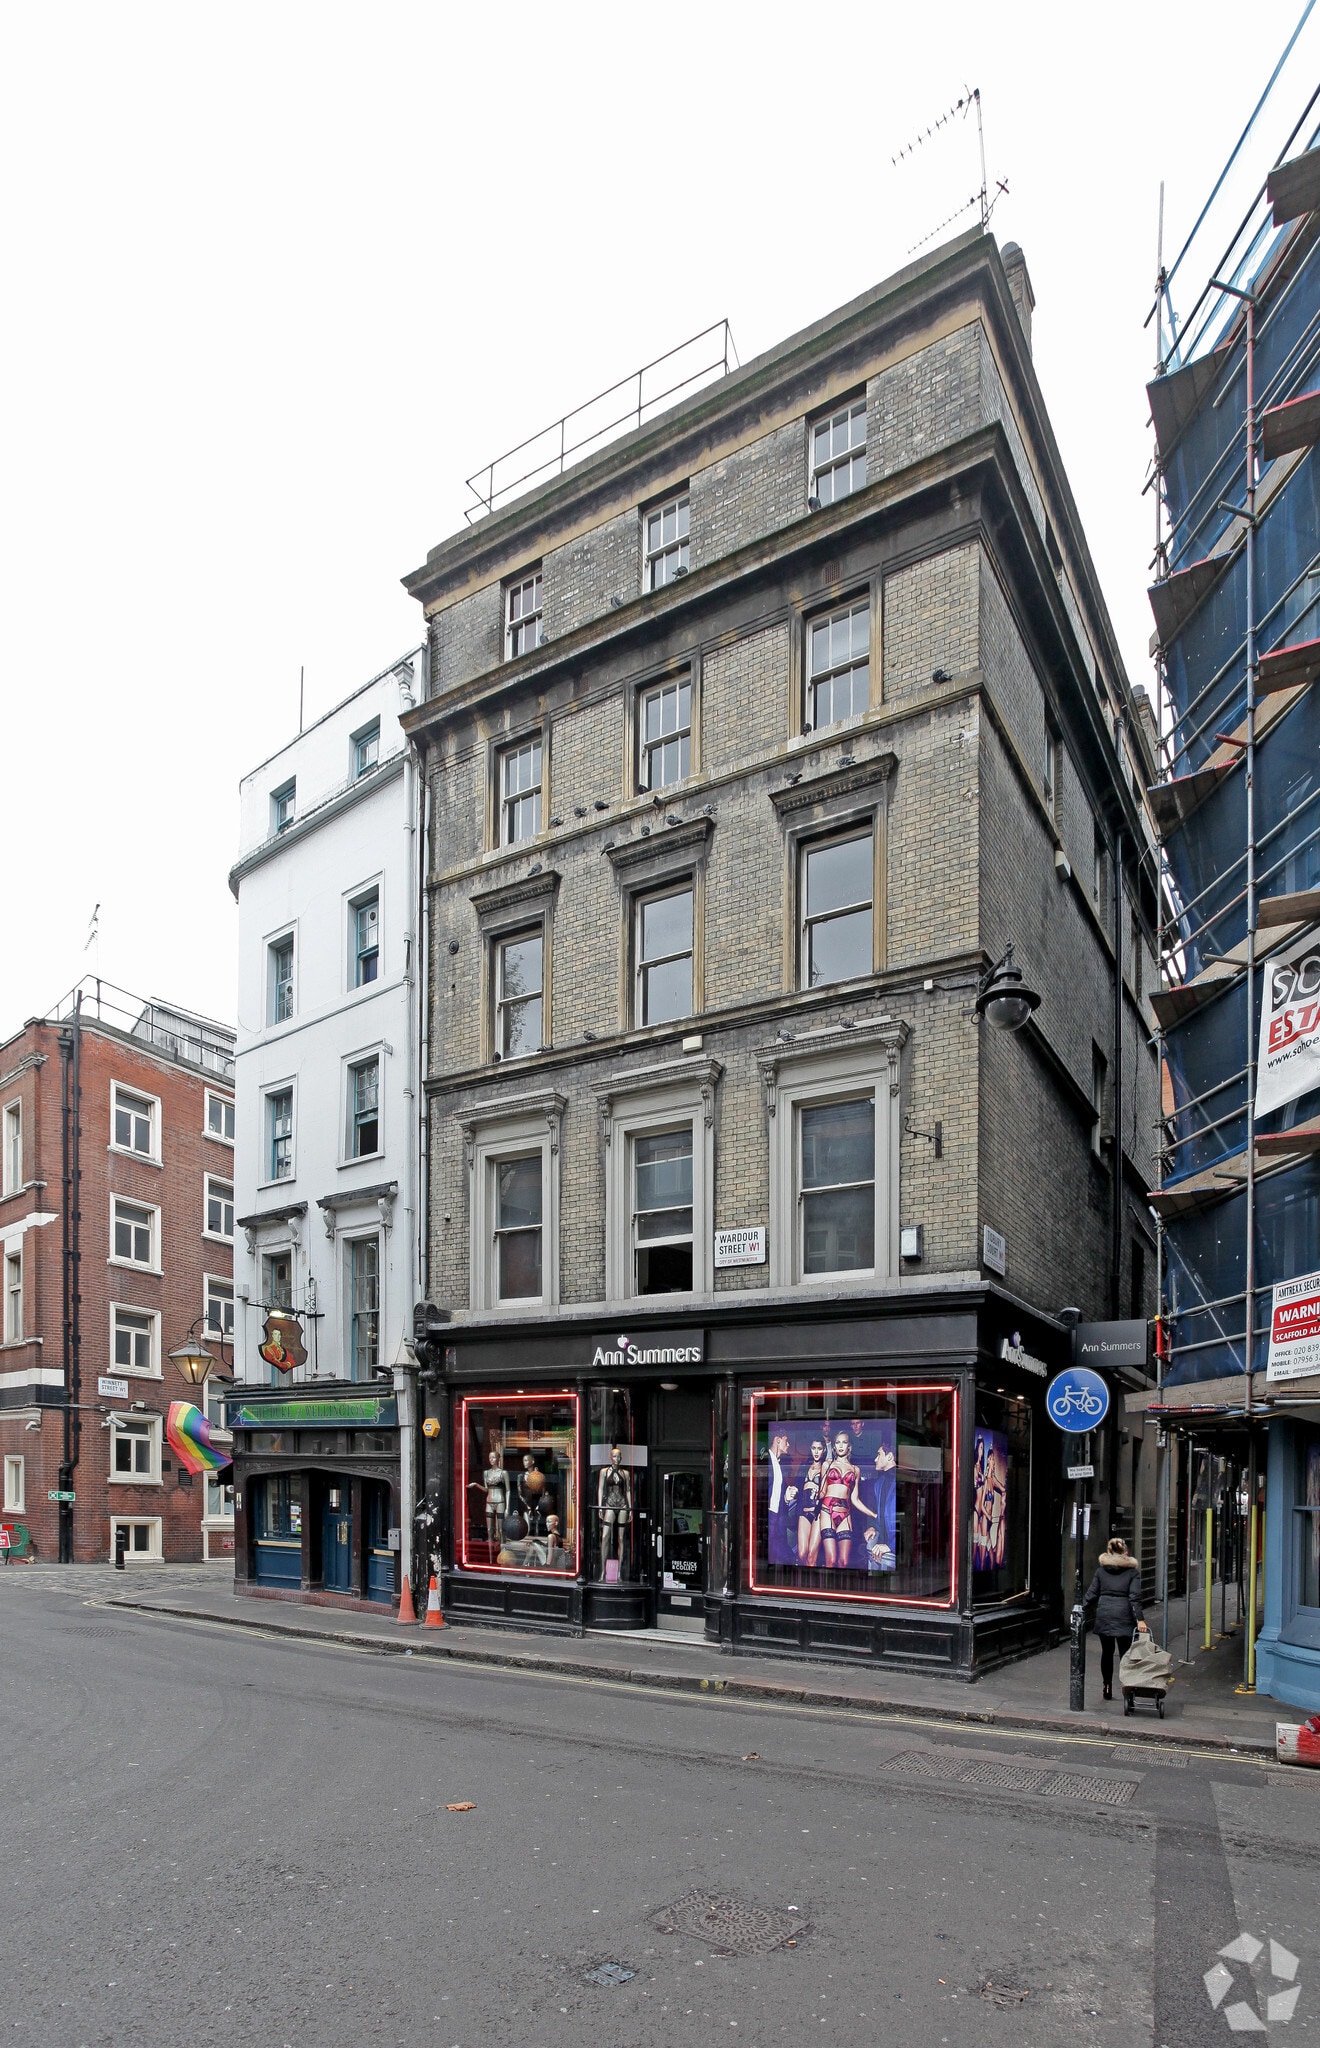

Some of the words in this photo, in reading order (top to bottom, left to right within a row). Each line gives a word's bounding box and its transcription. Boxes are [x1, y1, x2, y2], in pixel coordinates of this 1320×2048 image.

[720, 1231, 759, 1243] WARDOUR
[719, 1243, 746, 1255] STREET
[749, 1242, 760, 1252] W1
[1279, 1302, 1320, 1323] WARNI
[1275, 1328, 1308, 1342] SCAFFOLD
[1081, 1343, 1100, 1353] Ann
[1100, 1341, 1141, 1351] Summers
[1275, 1349, 1293, 1358] OFFICE:
[1294, 1346, 1306, 1355] 020
[592, 1346, 625, 1366] Ann
[626, 1344, 701, 1365] Summers
[1271, 1360, 1292, 1368] MOBILE:
[1293, 1355, 1313, 1365] 07956
[305, 1404, 365, 1416] WELLINGTON
